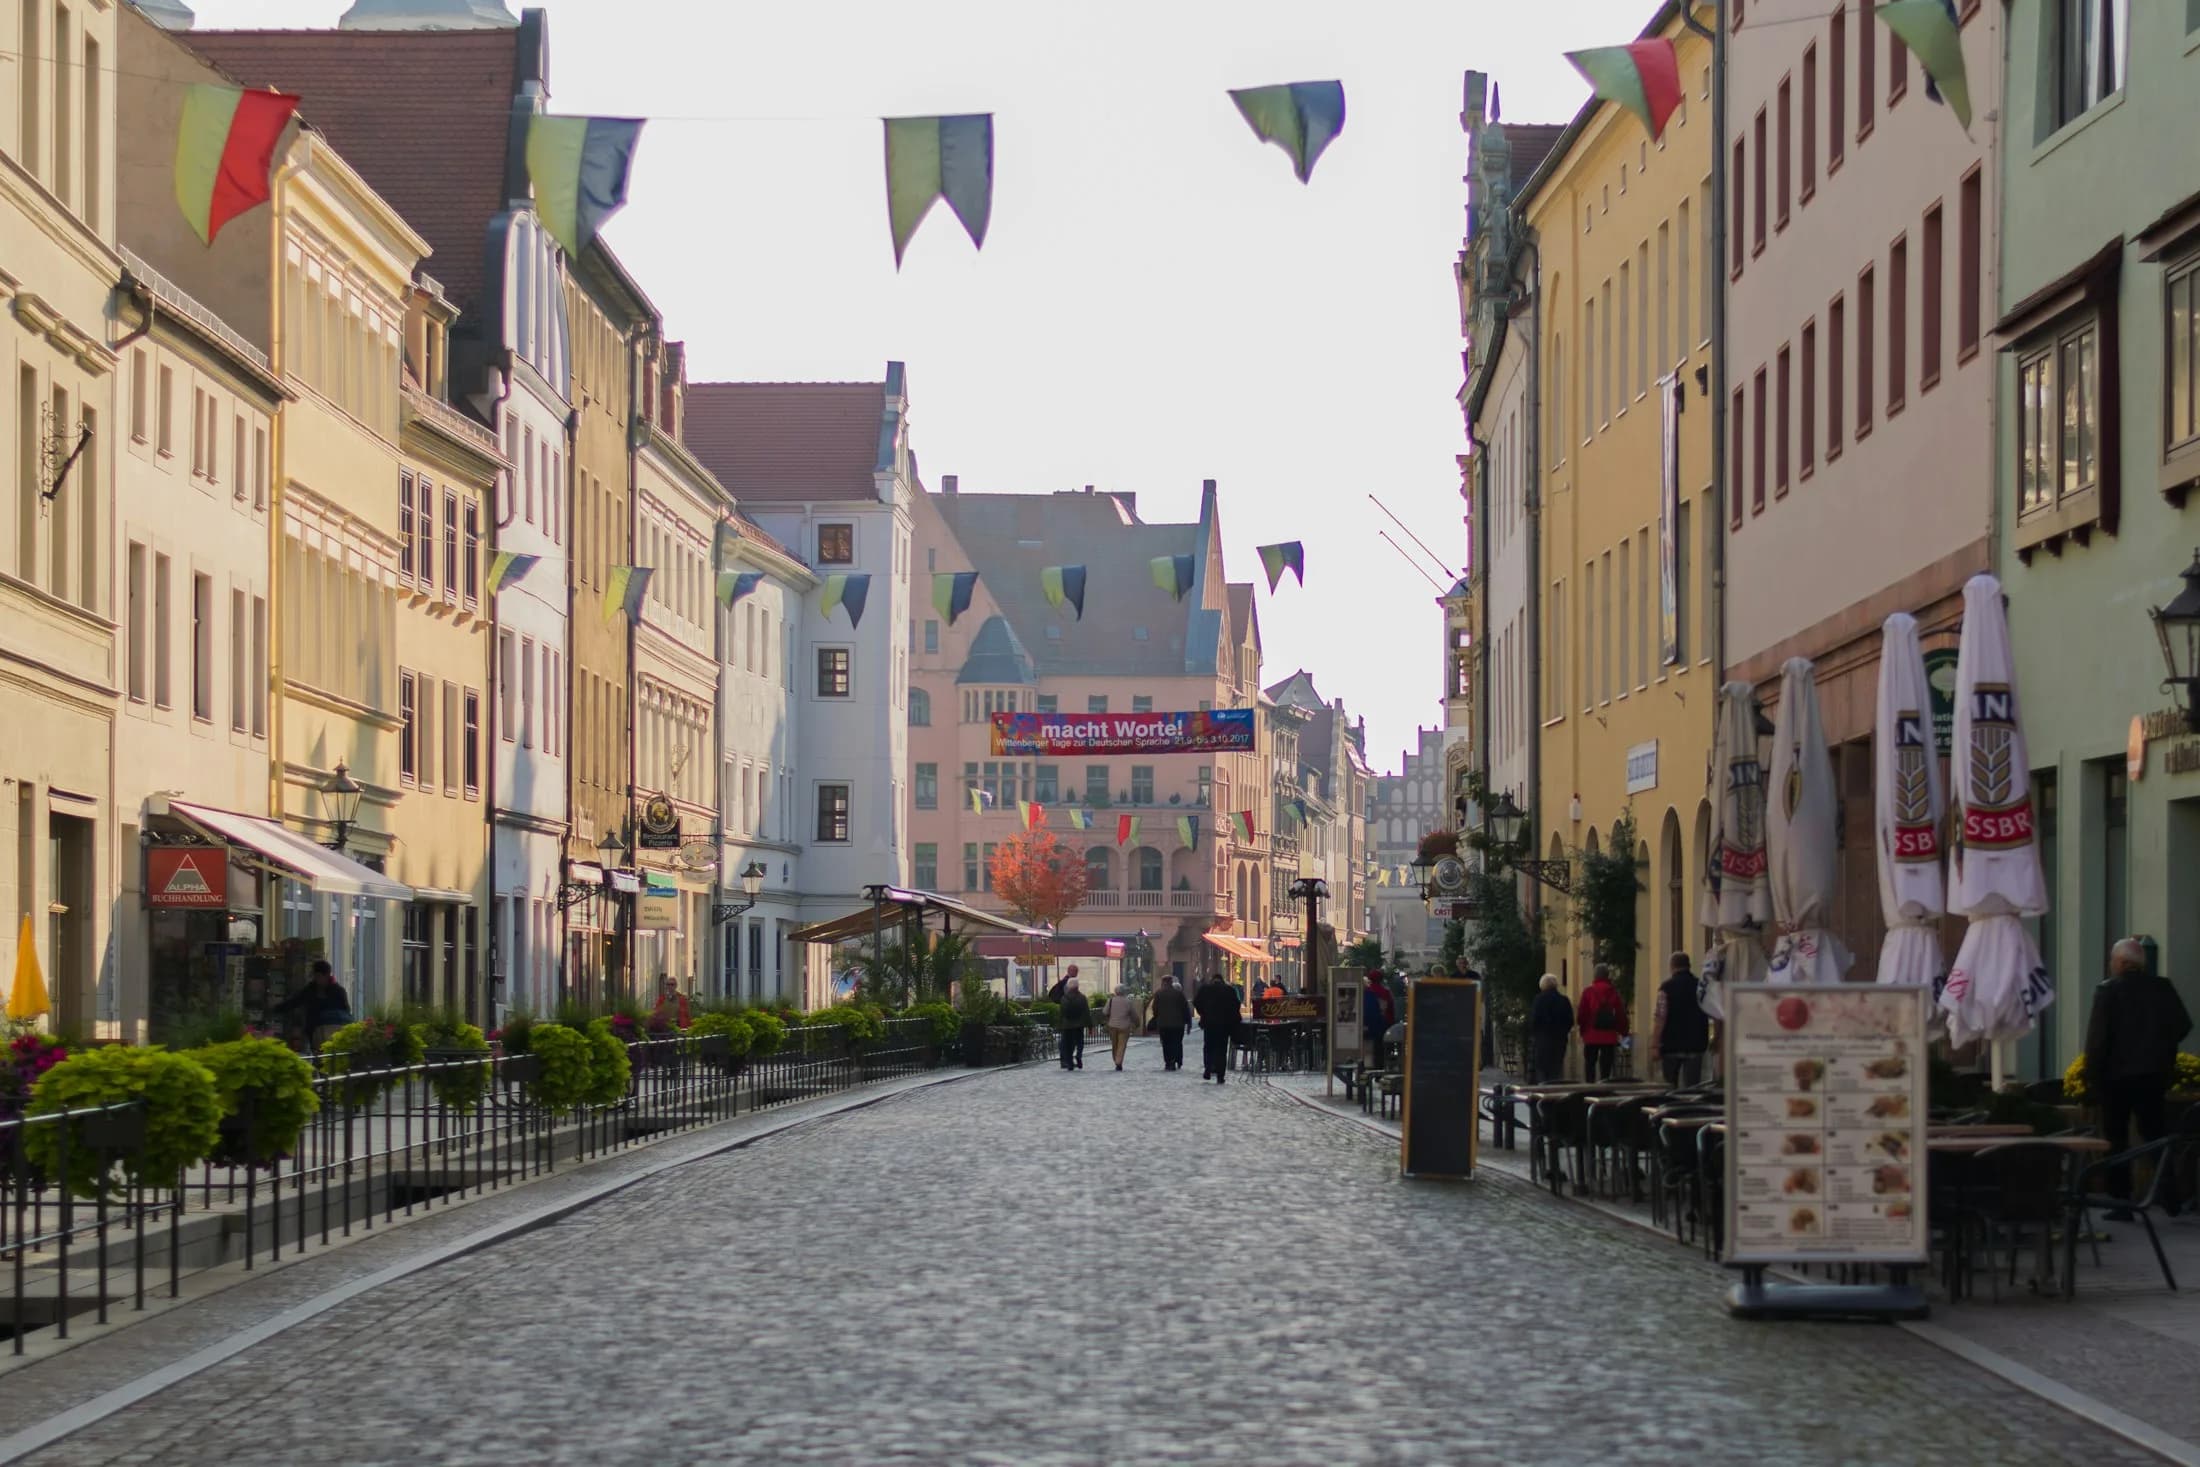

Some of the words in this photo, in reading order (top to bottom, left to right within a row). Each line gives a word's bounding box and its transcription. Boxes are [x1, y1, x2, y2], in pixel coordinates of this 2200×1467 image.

[1041, 721, 1109, 738] macht
[1114, 720, 1183, 737] Worte!
[995, 738, 1048, 748] Wittenberger
[1052, 738, 1071, 748] Tage
[1089, 737, 1133, 747] Deutschen
[1135, 737, 1170, 747] Sprache
[167, 883, 207, 891] ALPHA
[152, 894, 223, 903] BUCHHANDLUNG
